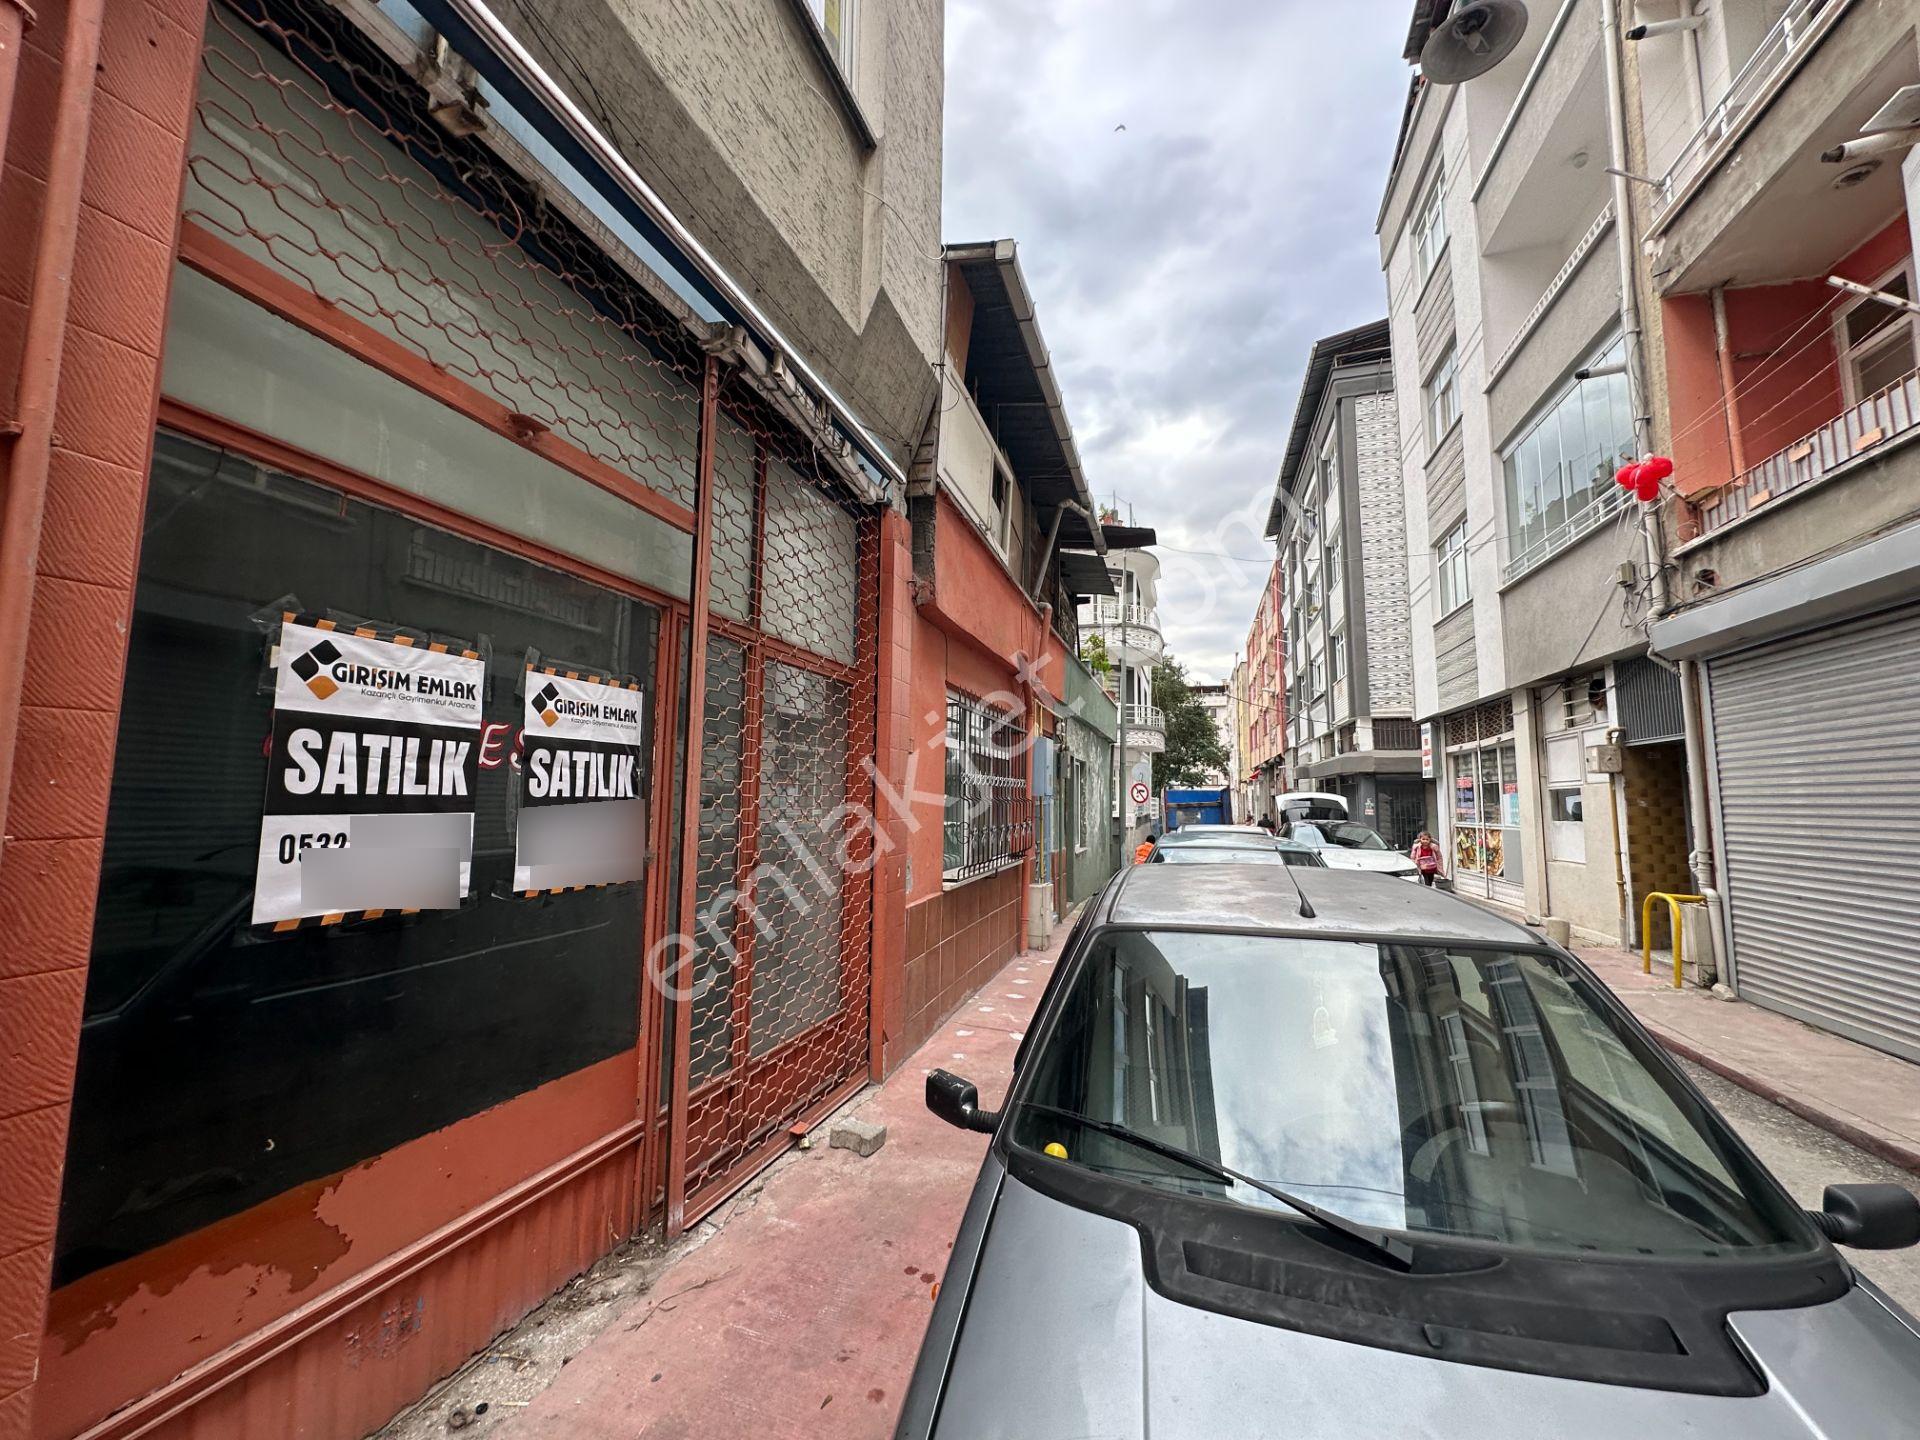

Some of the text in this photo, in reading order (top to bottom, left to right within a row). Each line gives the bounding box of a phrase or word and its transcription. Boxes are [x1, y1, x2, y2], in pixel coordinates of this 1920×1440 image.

[398, 692, 447, 706] Gayrimenkul
[417, 676, 476, 700] EMLAK
[603, 706, 637, 723] EMLAK
[284, 728, 471, 796] SATILIK
[529, 748, 635, 798] SATILIK
